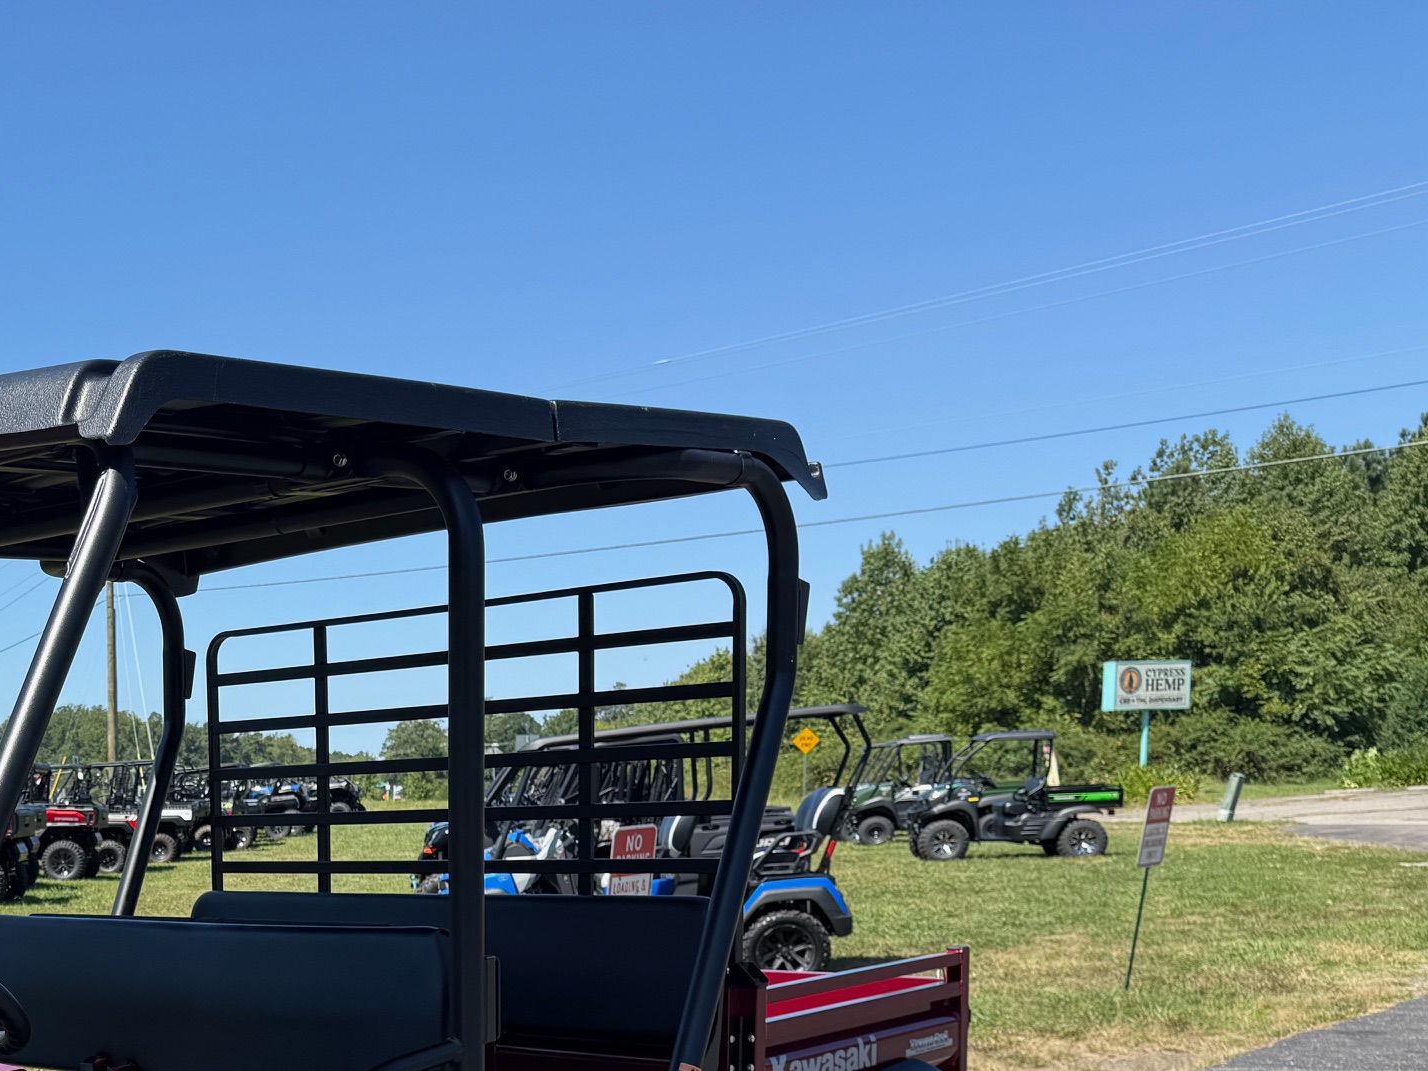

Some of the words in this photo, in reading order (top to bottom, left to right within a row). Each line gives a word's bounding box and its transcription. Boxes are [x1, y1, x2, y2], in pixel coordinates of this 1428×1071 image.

[1145, 667, 1186, 678] CYPRESS
[1145, 678, 1185, 692] HEMP
[625, 833, 643, 852] NO
[613, 880, 640, 894] LOADING
